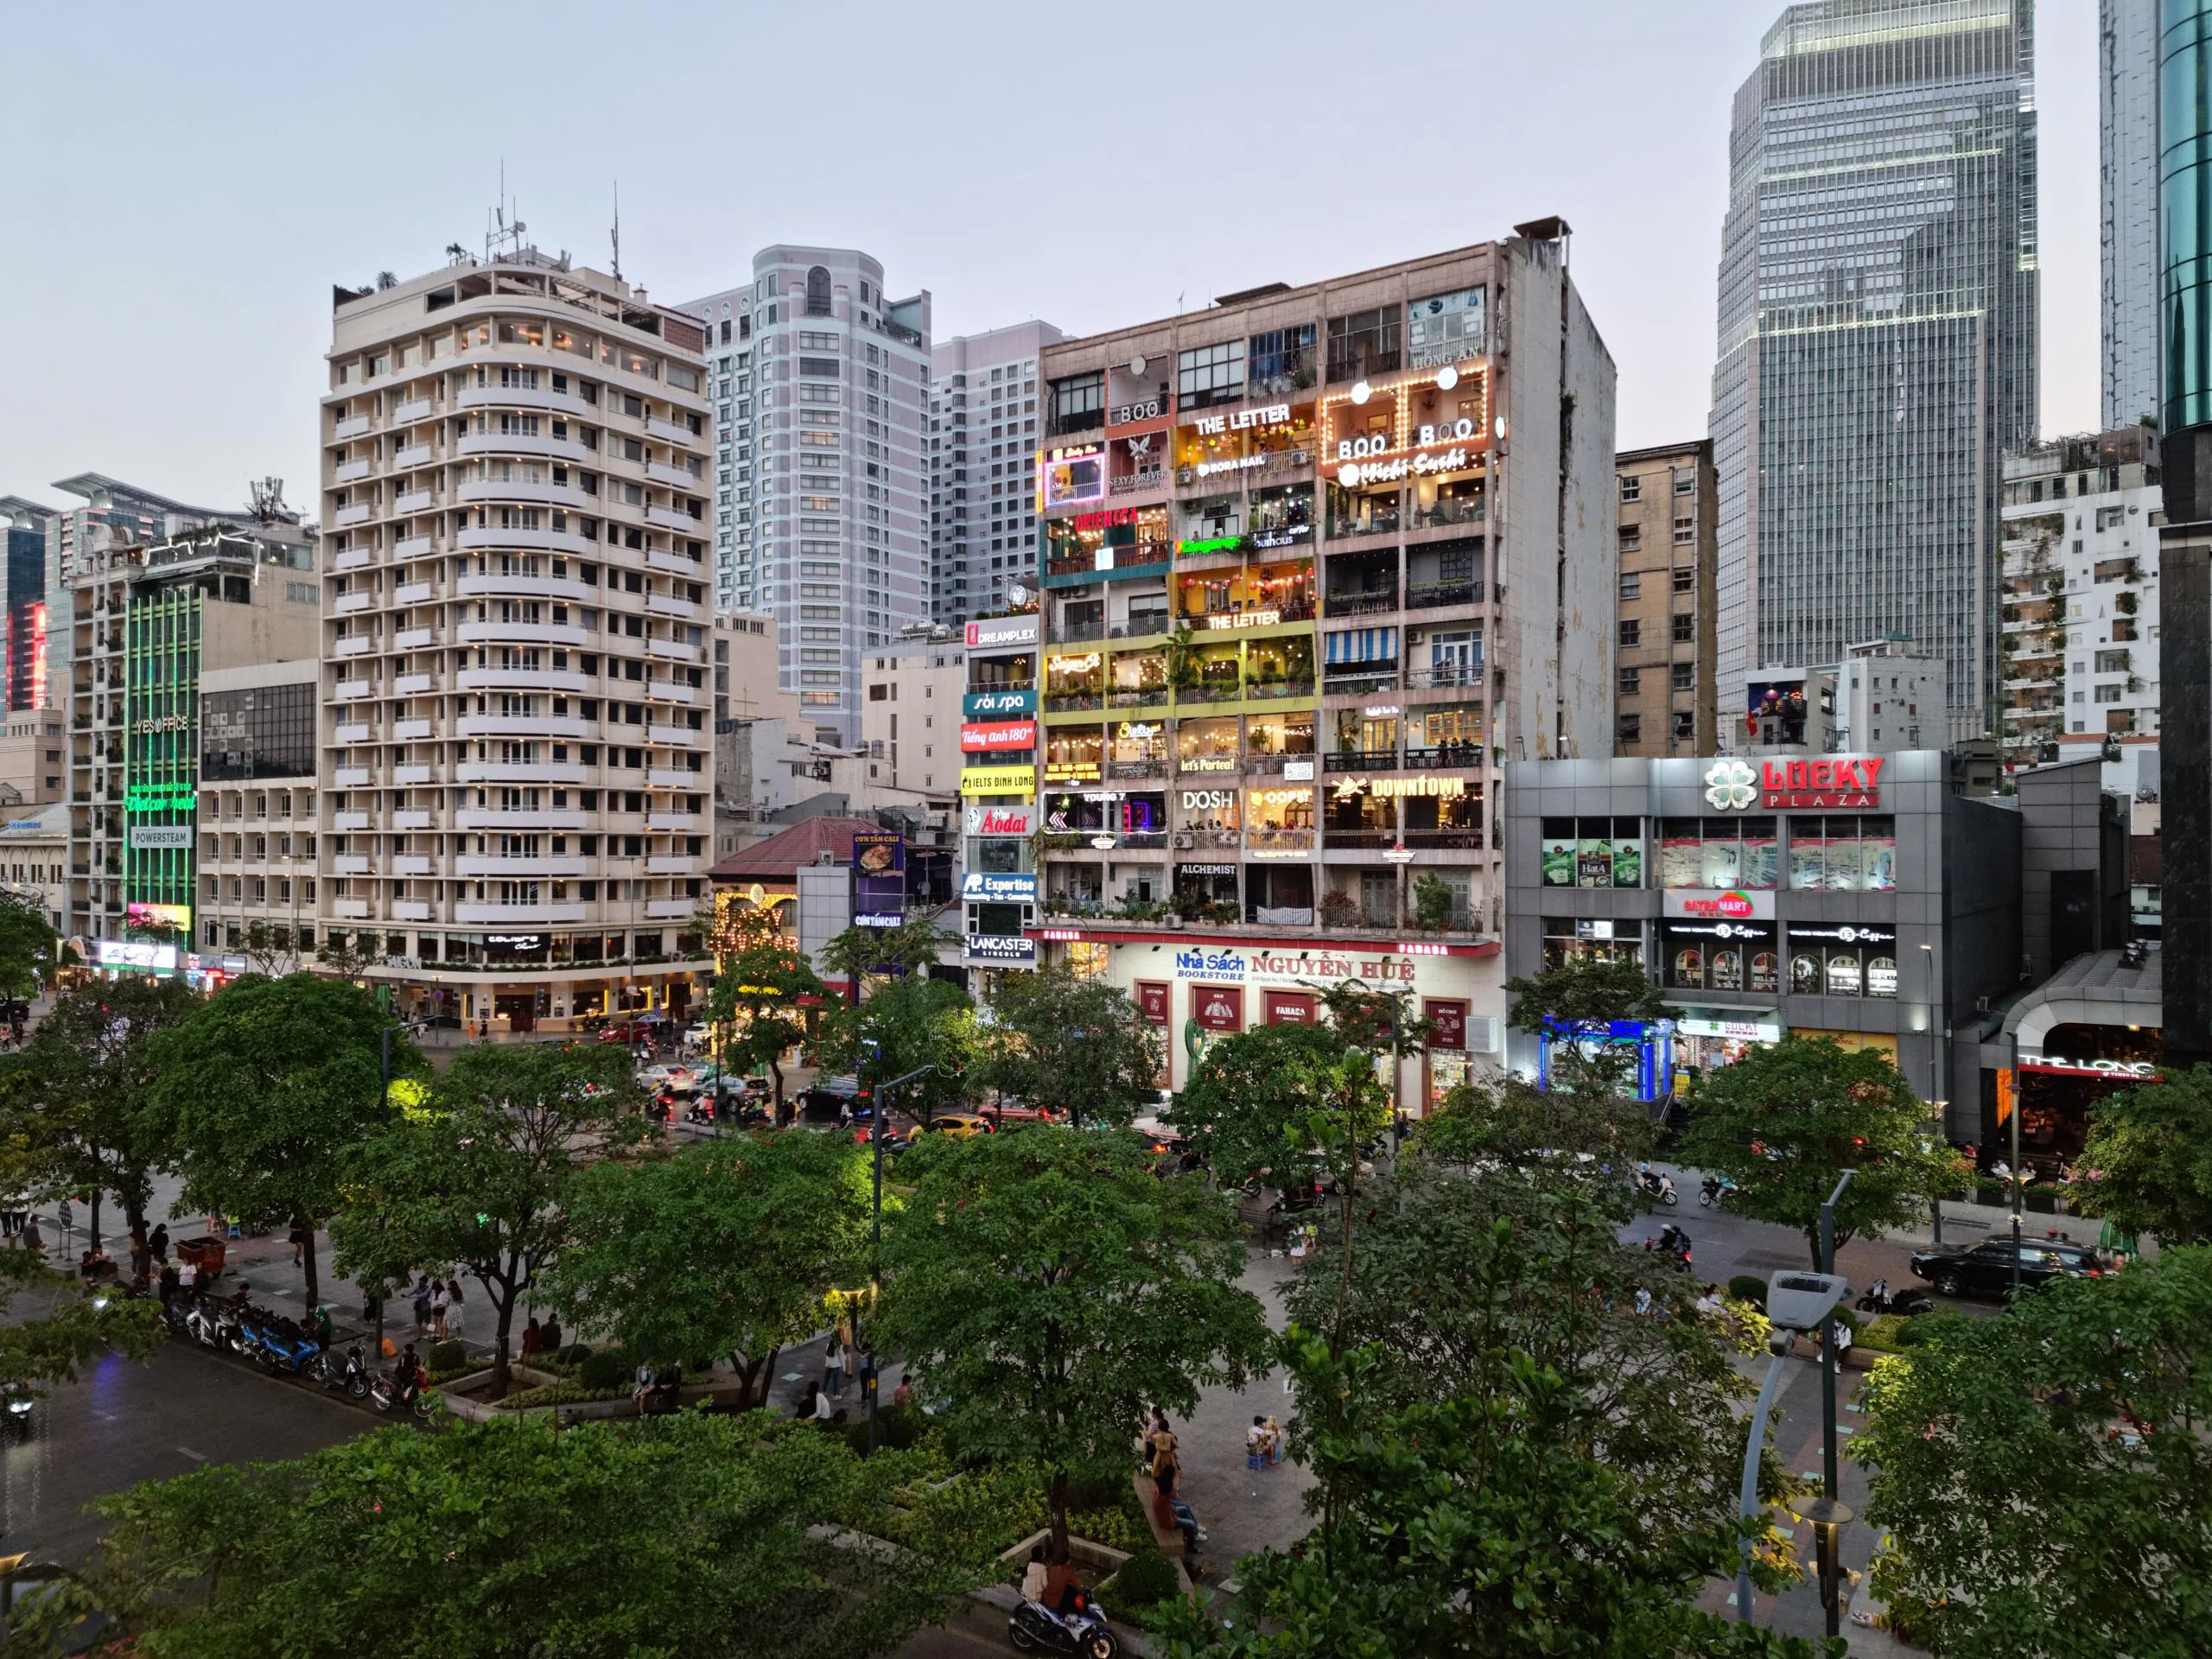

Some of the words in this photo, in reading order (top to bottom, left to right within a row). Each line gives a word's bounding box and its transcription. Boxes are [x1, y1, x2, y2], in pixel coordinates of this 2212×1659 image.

[1121, 401, 1159, 423] BOO
[1195, 415, 1226, 435] THE
[1230, 404, 1290, 429] LETTER
[1420, 417, 1472, 446] BOO
[1339, 435, 1386, 460] BOO
[1240, 455, 1265, 468] NAIL
[1359, 457, 1408, 484] Michi
[1414, 448, 1466, 476] Sushi
[1109, 475, 1129, 487] SEXY
[1129, 469, 1166, 484] FOREVER
[1209, 615, 1231, 630] THE
[1233, 611, 1280, 628] LETTER
[977, 628, 1036, 644] DREAMPLEX
[997, 695, 1025, 712] spa
[962, 728, 987, 746] Tiếng
[973, 778, 992, 787] IELTS
[1014, 776, 1033, 786] LONG
[1763, 758, 1885, 791] LUCKY
[1084, 793, 1116, 802] YOUNG
[1183, 791, 1233, 810] DOSH
[1770, 795, 1870, 806] PLAZA
[136, 832, 187, 844] POWERSTEAM
[1181, 865, 1236, 874] ALCHEMIST
[985, 877, 1034, 893] Expertise
[970, 937, 1033, 951] LANCASTER
[1399, 944, 1448, 956] FAHASA
[1177, 969, 1245, 981] BOOKSTORE
[1250, 951, 1353, 978] NGUYỄN
[1360, 957, 1416, 986] HUỆ
[2018, 1054, 2077, 1069] THE
[2078, 1058, 2156, 1073] LONG
